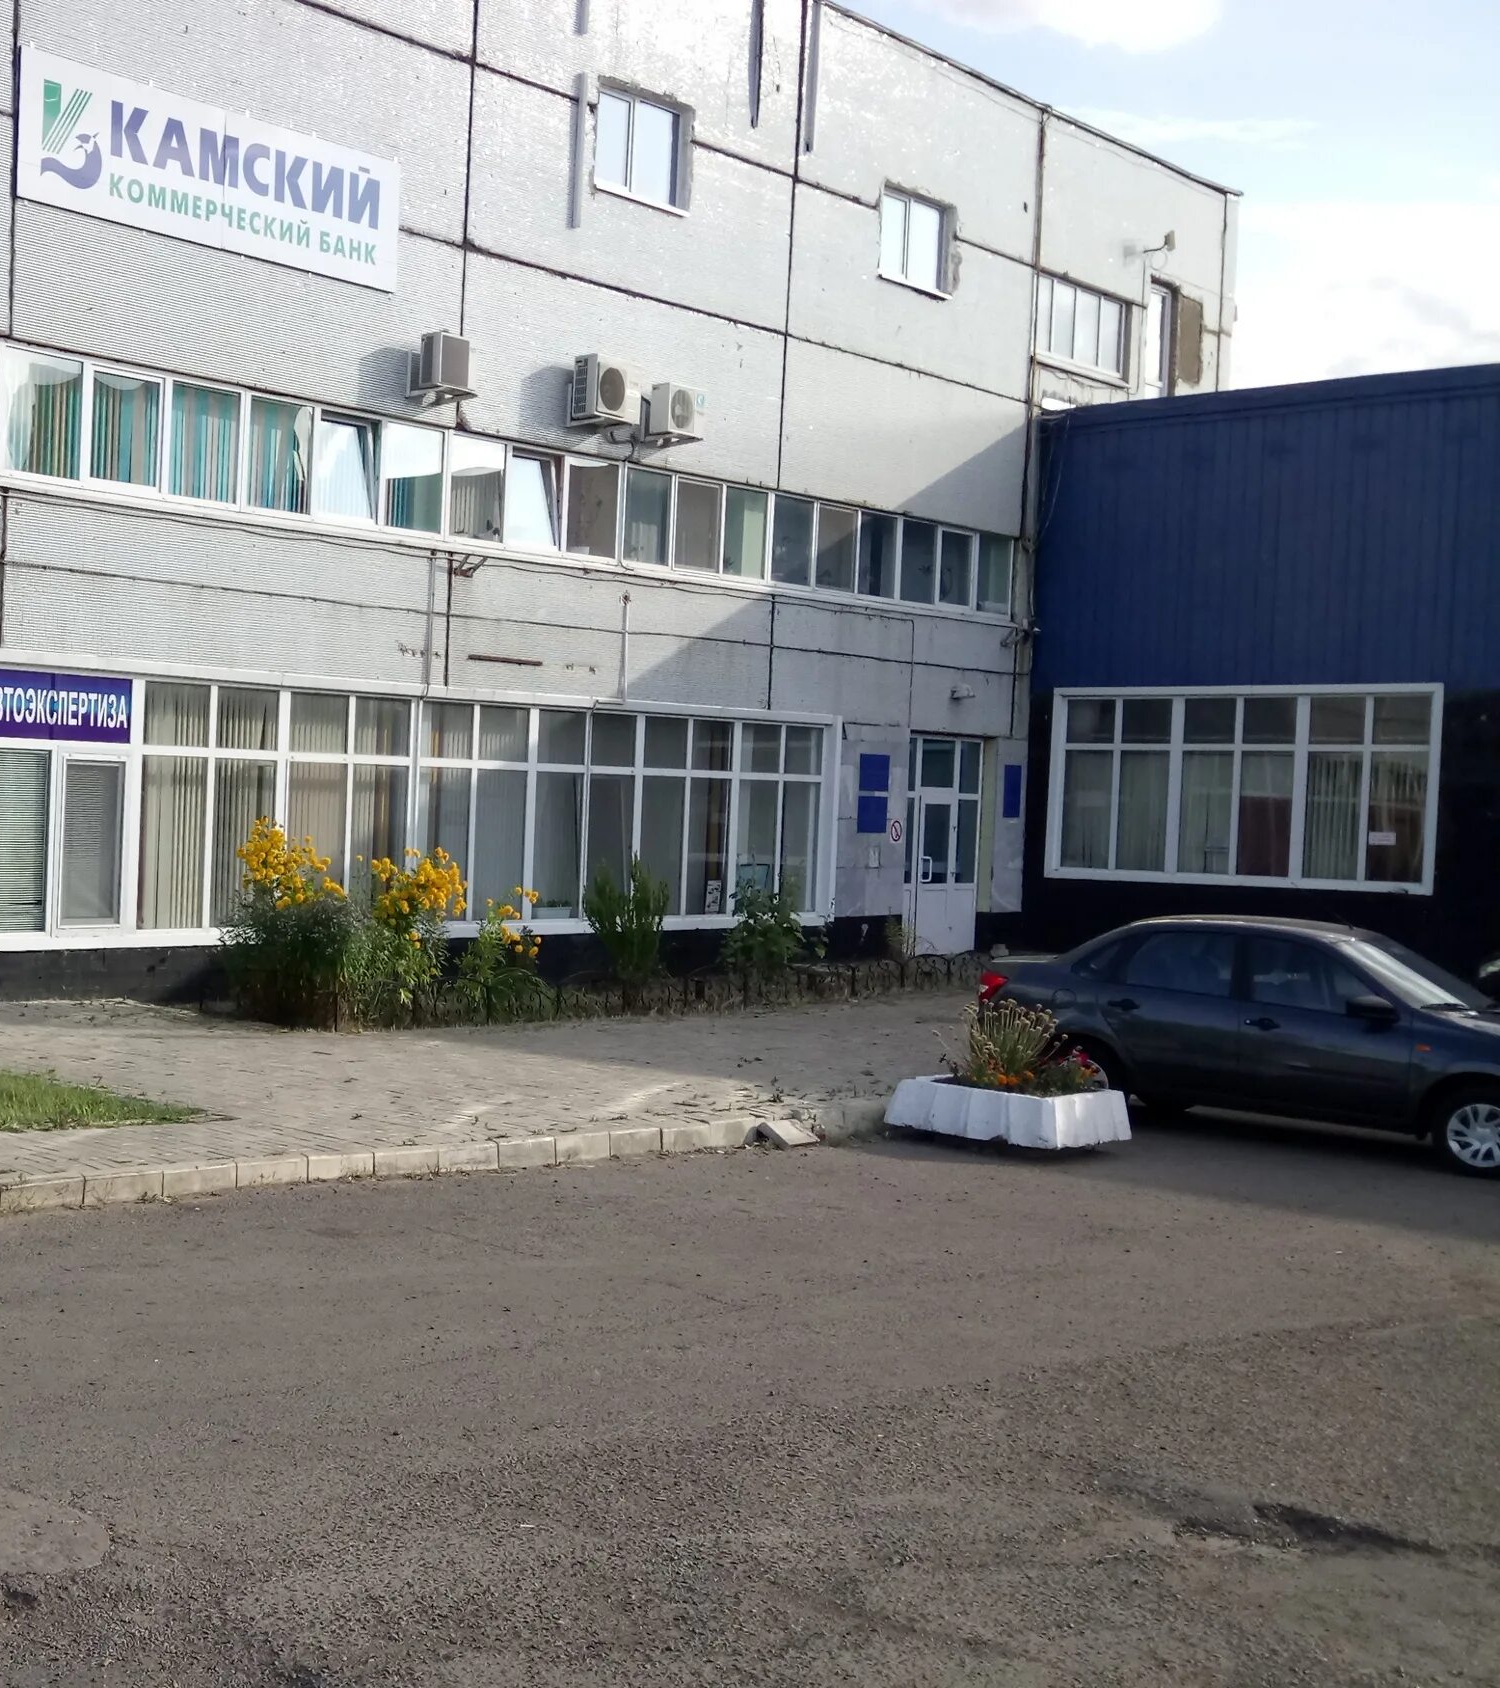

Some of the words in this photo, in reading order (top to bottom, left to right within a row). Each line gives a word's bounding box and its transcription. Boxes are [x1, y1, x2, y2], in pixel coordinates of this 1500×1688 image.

[108, 172, 311, 249] КОММЕРЧЕСКИЙ
[319, 230, 377, 266] БАНК
[110, 99, 381, 230] КАМСКИЙ
